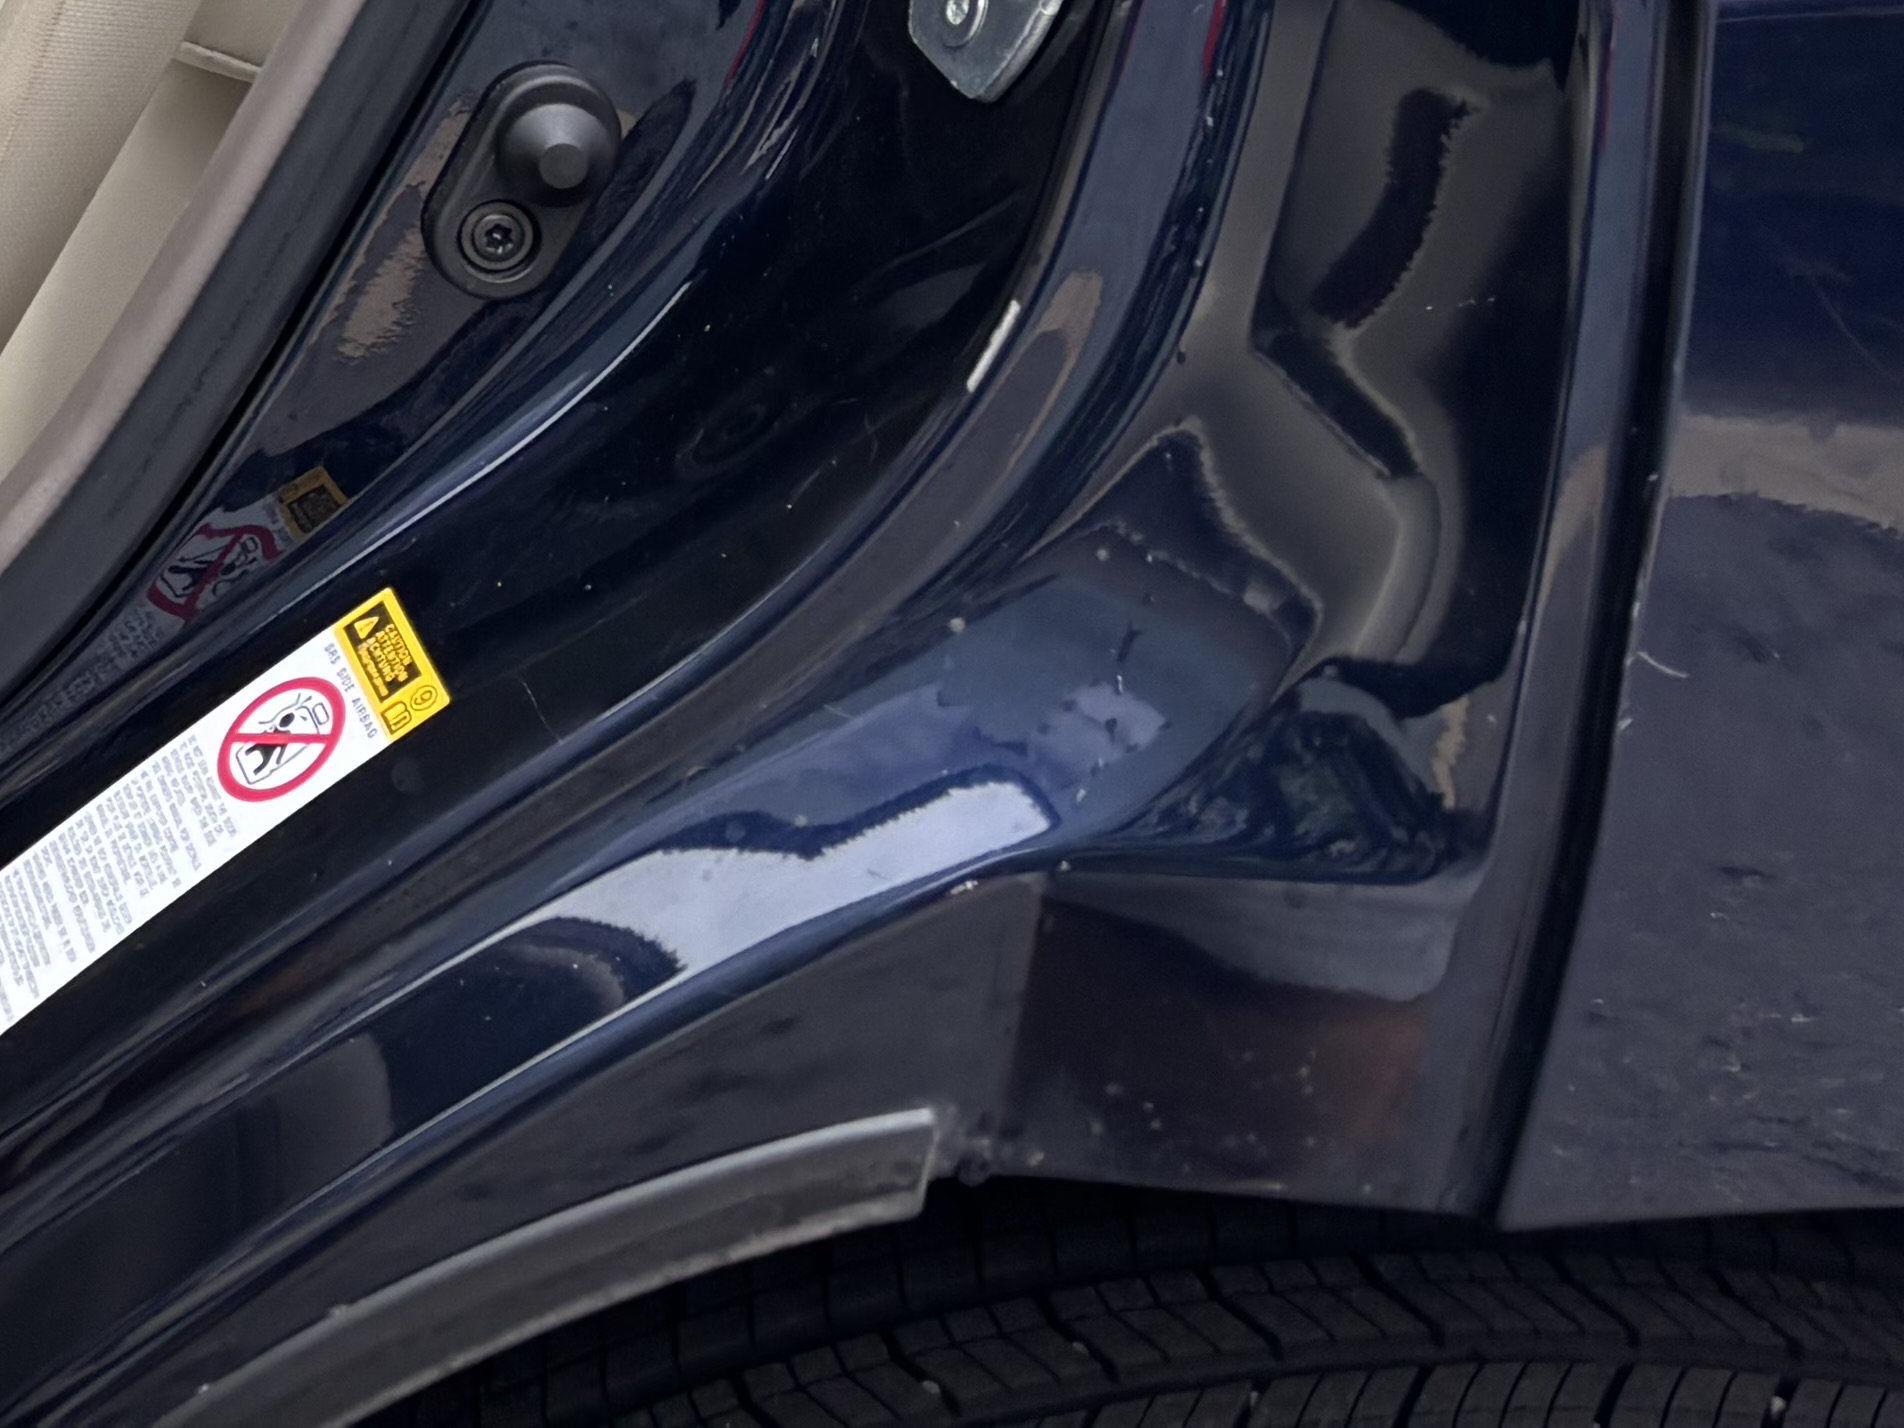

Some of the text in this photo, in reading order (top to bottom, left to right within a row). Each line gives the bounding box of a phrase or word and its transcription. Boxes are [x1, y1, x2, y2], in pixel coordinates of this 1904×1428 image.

[366, 636, 395, 683] ACHTUNG
[375, 630, 409, 683] ATTENTION
[385, 623, 413, 666] CAUTION
[324, 642, 341, 665] SRS
[336, 667, 355, 693] SIDE
[351, 697, 379, 739] AIRBAG
